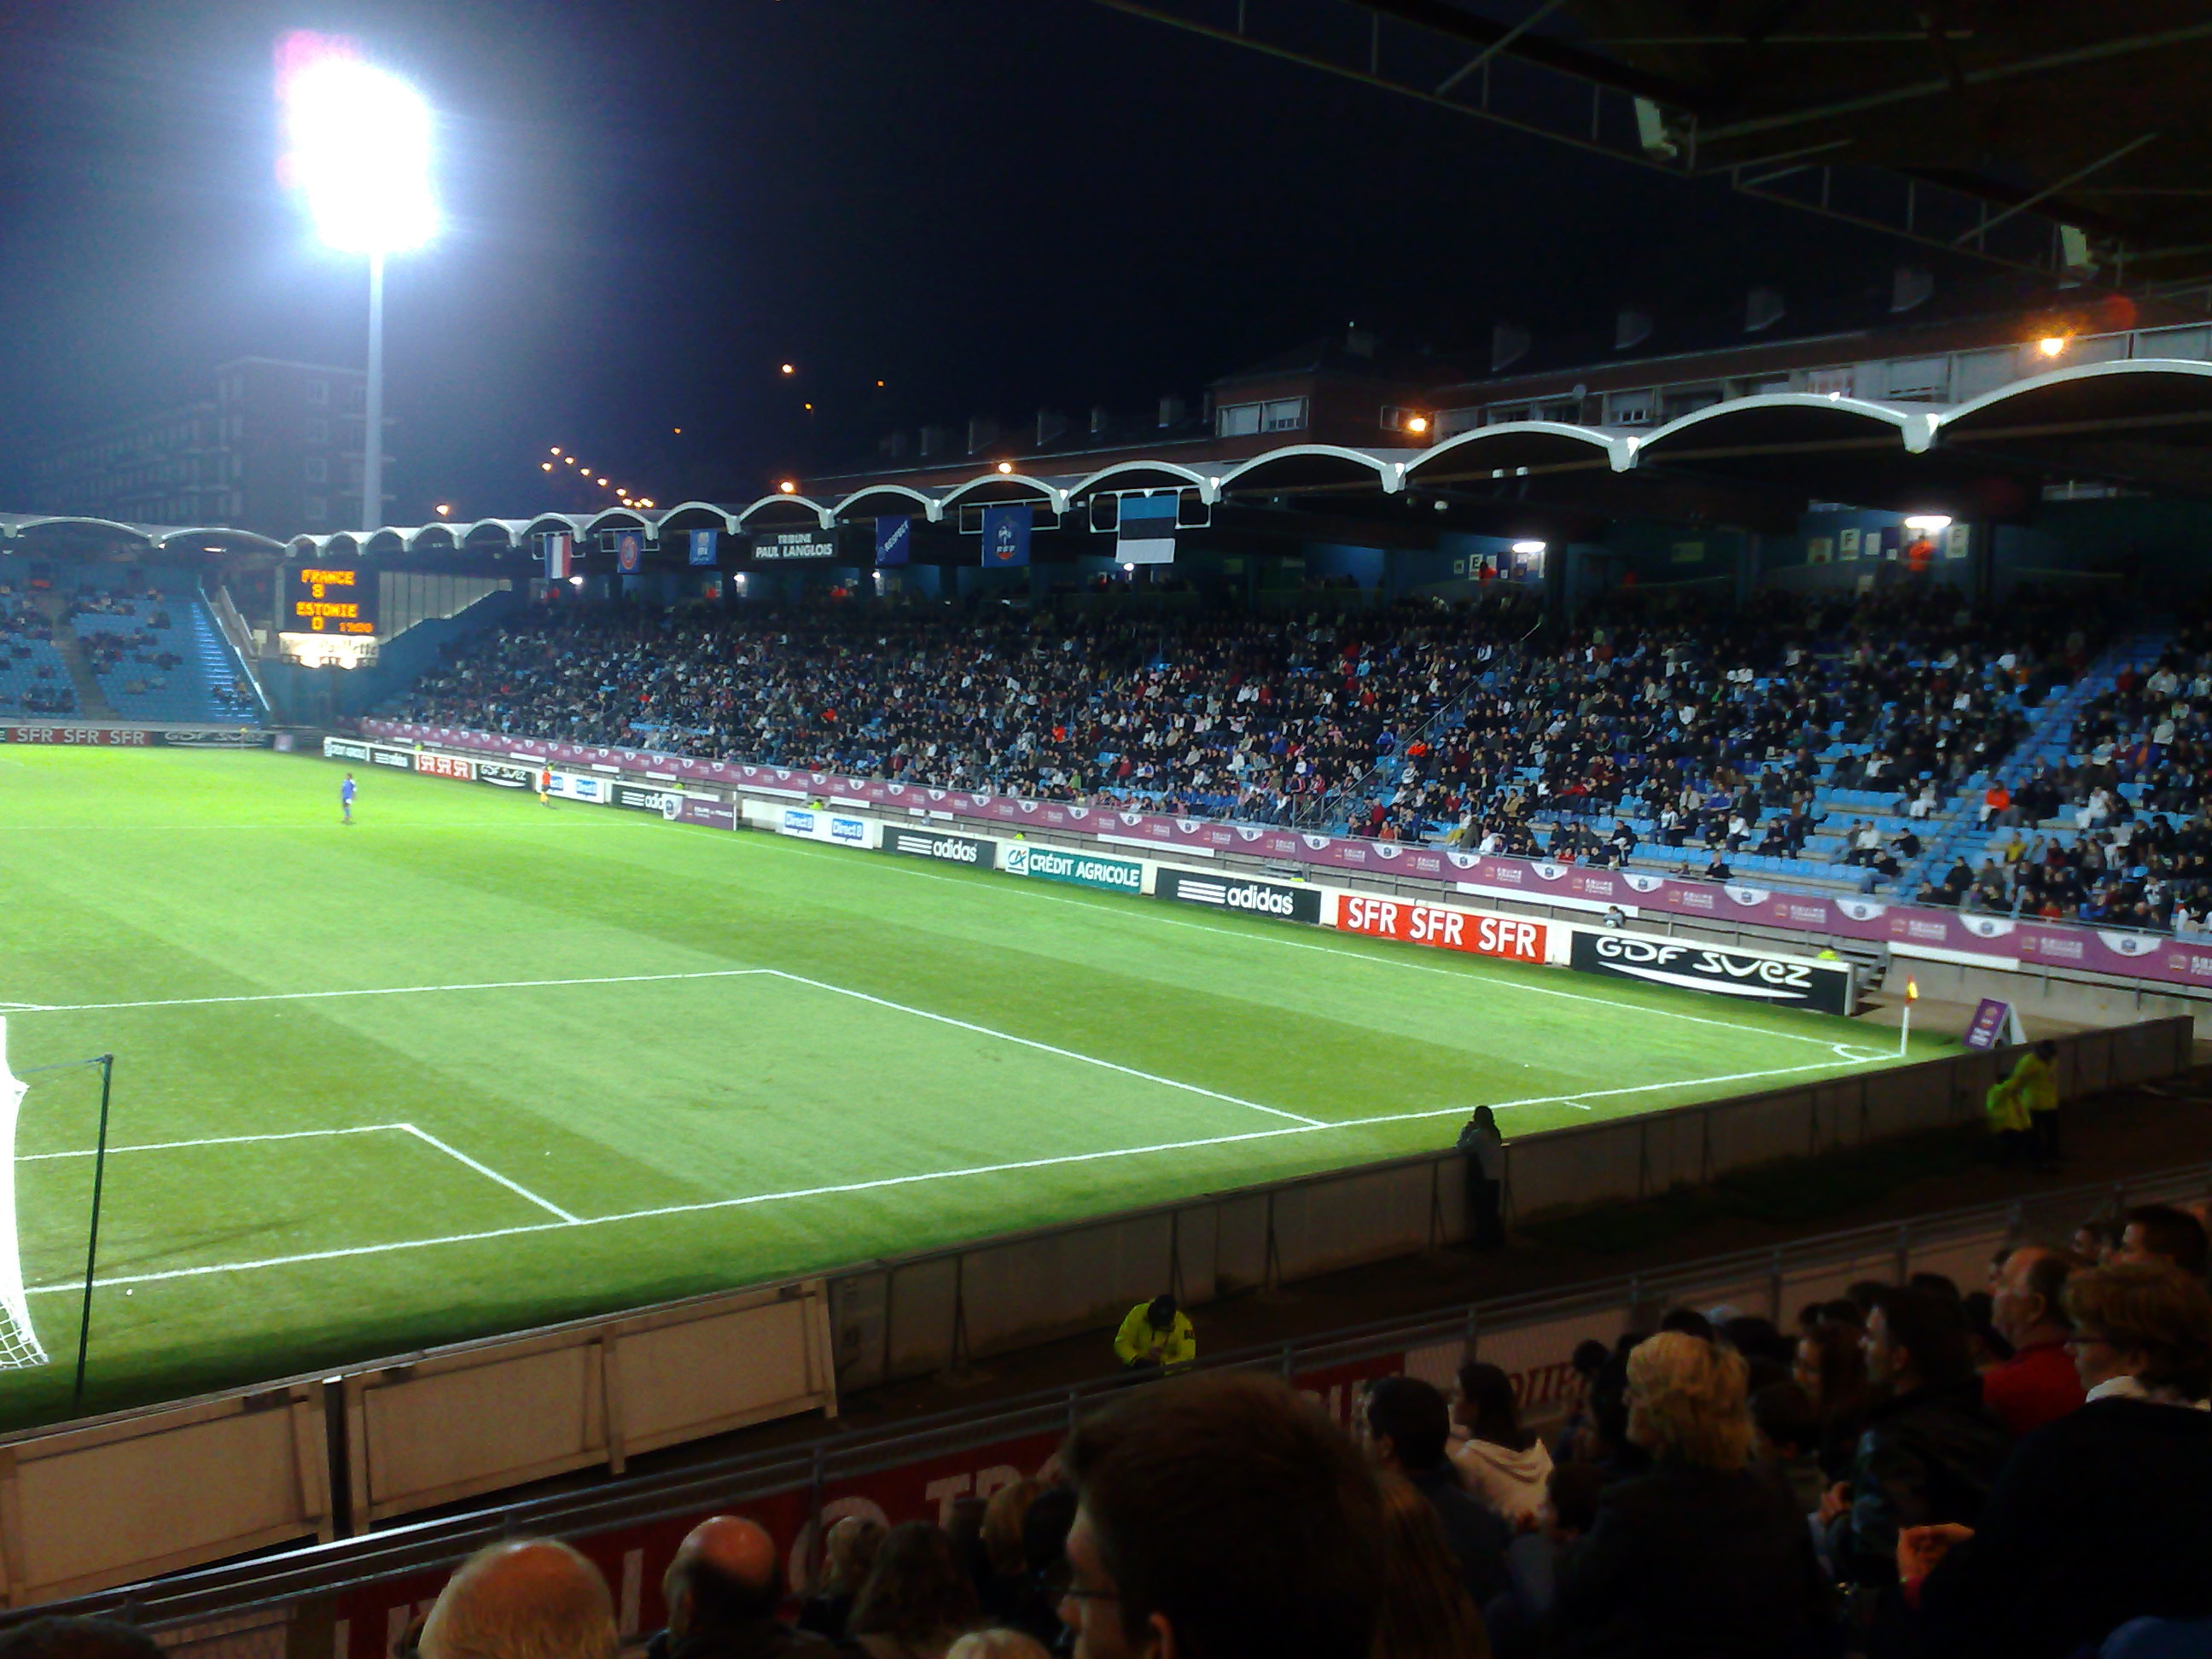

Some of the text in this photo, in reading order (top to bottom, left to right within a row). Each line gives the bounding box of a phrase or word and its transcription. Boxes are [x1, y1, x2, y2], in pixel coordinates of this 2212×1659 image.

[777, 533, 812, 545] TRIBUNE
[755, 544, 834, 559] PAUL LANGLOIS
[301, 569, 355, 585] FRANCE
[296, 602, 358, 618] ESTONIE
[311, 616, 324, 631] 0
[16, 728, 53, 743] SFR
[63, 730, 100, 744] SFR
[109, 731, 145, 745] SFR
[933, 838, 976, 862] adidas
[1030, 853, 1140, 888] CRÉDIT AGRICOLE
[1226, 885, 1293, 916] adidas
[1347, 897, 1537, 958] SFR SFR SFR
[1596, 936, 1687, 965] GDF
